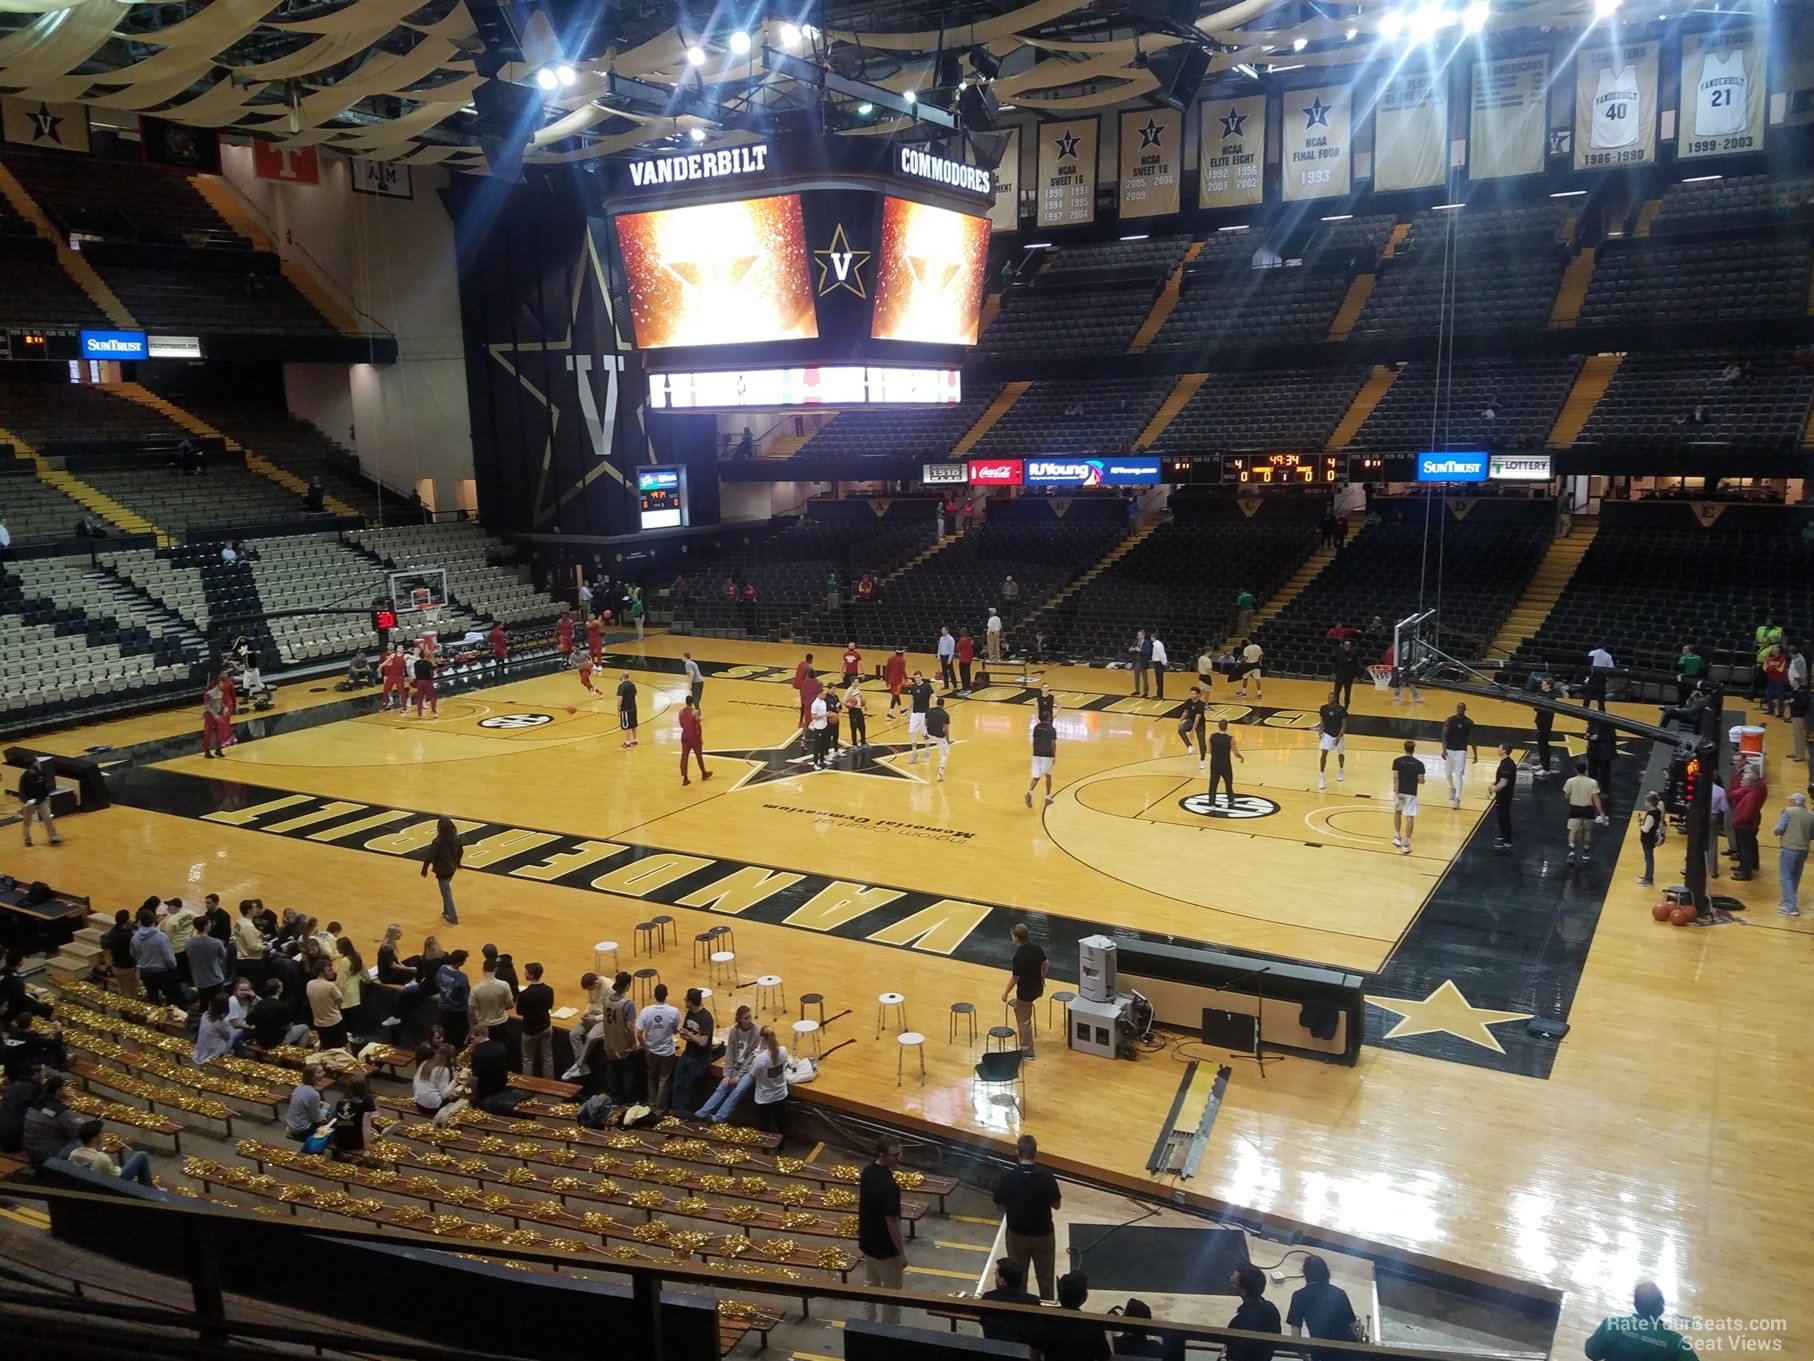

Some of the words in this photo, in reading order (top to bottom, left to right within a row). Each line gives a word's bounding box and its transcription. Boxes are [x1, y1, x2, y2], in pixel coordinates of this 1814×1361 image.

[1700, 77, 1745, 91] VANDERBILT
[1596, 92, 1637, 105] VANDERBILT
[1712, 89, 1731, 107] 21
[1312, 107, 1322, 121] V
[1606, 103, 1627, 120] 40
[42, 116, 52, 135] V
[1229, 117, 1238, 131] V
[1147, 128, 1156, 141] V
[1062, 140, 1073, 151] V
[1305, 136, 1327, 147] NCAA
[1222, 144, 1243, 155] NCAA
[1293, 149, 1315, 162] FINAL
[1318, 147, 1340, 159] FOUR
[629, 145, 768, 187] VANDERBILT
[1141, 155, 1160, 165] NCAA
[1210, 157, 1229, 168] ELITE
[1232, 154, 1254, 165] EIGHT
[901, 148, 991, 193] COMMODORES
[1058, 165, 1077, 176] NCAA
[1133, 166, 1155, 177] SWEET
[1159, 164, 1168, 174] 16
[1208, 169, 1228, 180] 1992
[1051, 176, 1072, 187] SWEET
[1075, 175, 1084, 184] 16
[1126, 178, 1146, 189] 2005
[1301, 170, 1330, 185] 1993
[1045, 188, 1063, 198] 1990
[1071, 186, 1088, 196] 1991
[1207, 181, 1228, 192] 2001
[1045, 200, 1063, 210] 1994
[1044, 212, 1063, 221] 1997
[831, 252, 853, 281] V
[565, 355, 625, 455] V
[1235, 459, 1242, 469] 4
[1270, 455, 1299, 466] 49:34
[1327, 458, 1336, 468] 4
[1505, 461, 1547, 470] LOTTERY
[1029, 463, 1089, 479] RJYoung
[1241, 471, 1248, 482] 0
[1264, 471, 1271, 482] 0
[1305, 471, 1313, 482] 0
[1327, 470, 1335, 481] 0
[1702, 506, 1715, 519] E
[762, 803, 870, 824] Gymnasium
[838, 820, 890, 833] Court
[875, 819, 976, 839] Memorial
[898, 829, 967, 845] Ingram
[200, 795, 993, 956] VANDERBILT
[606, 1007, 617, 1024] 24
